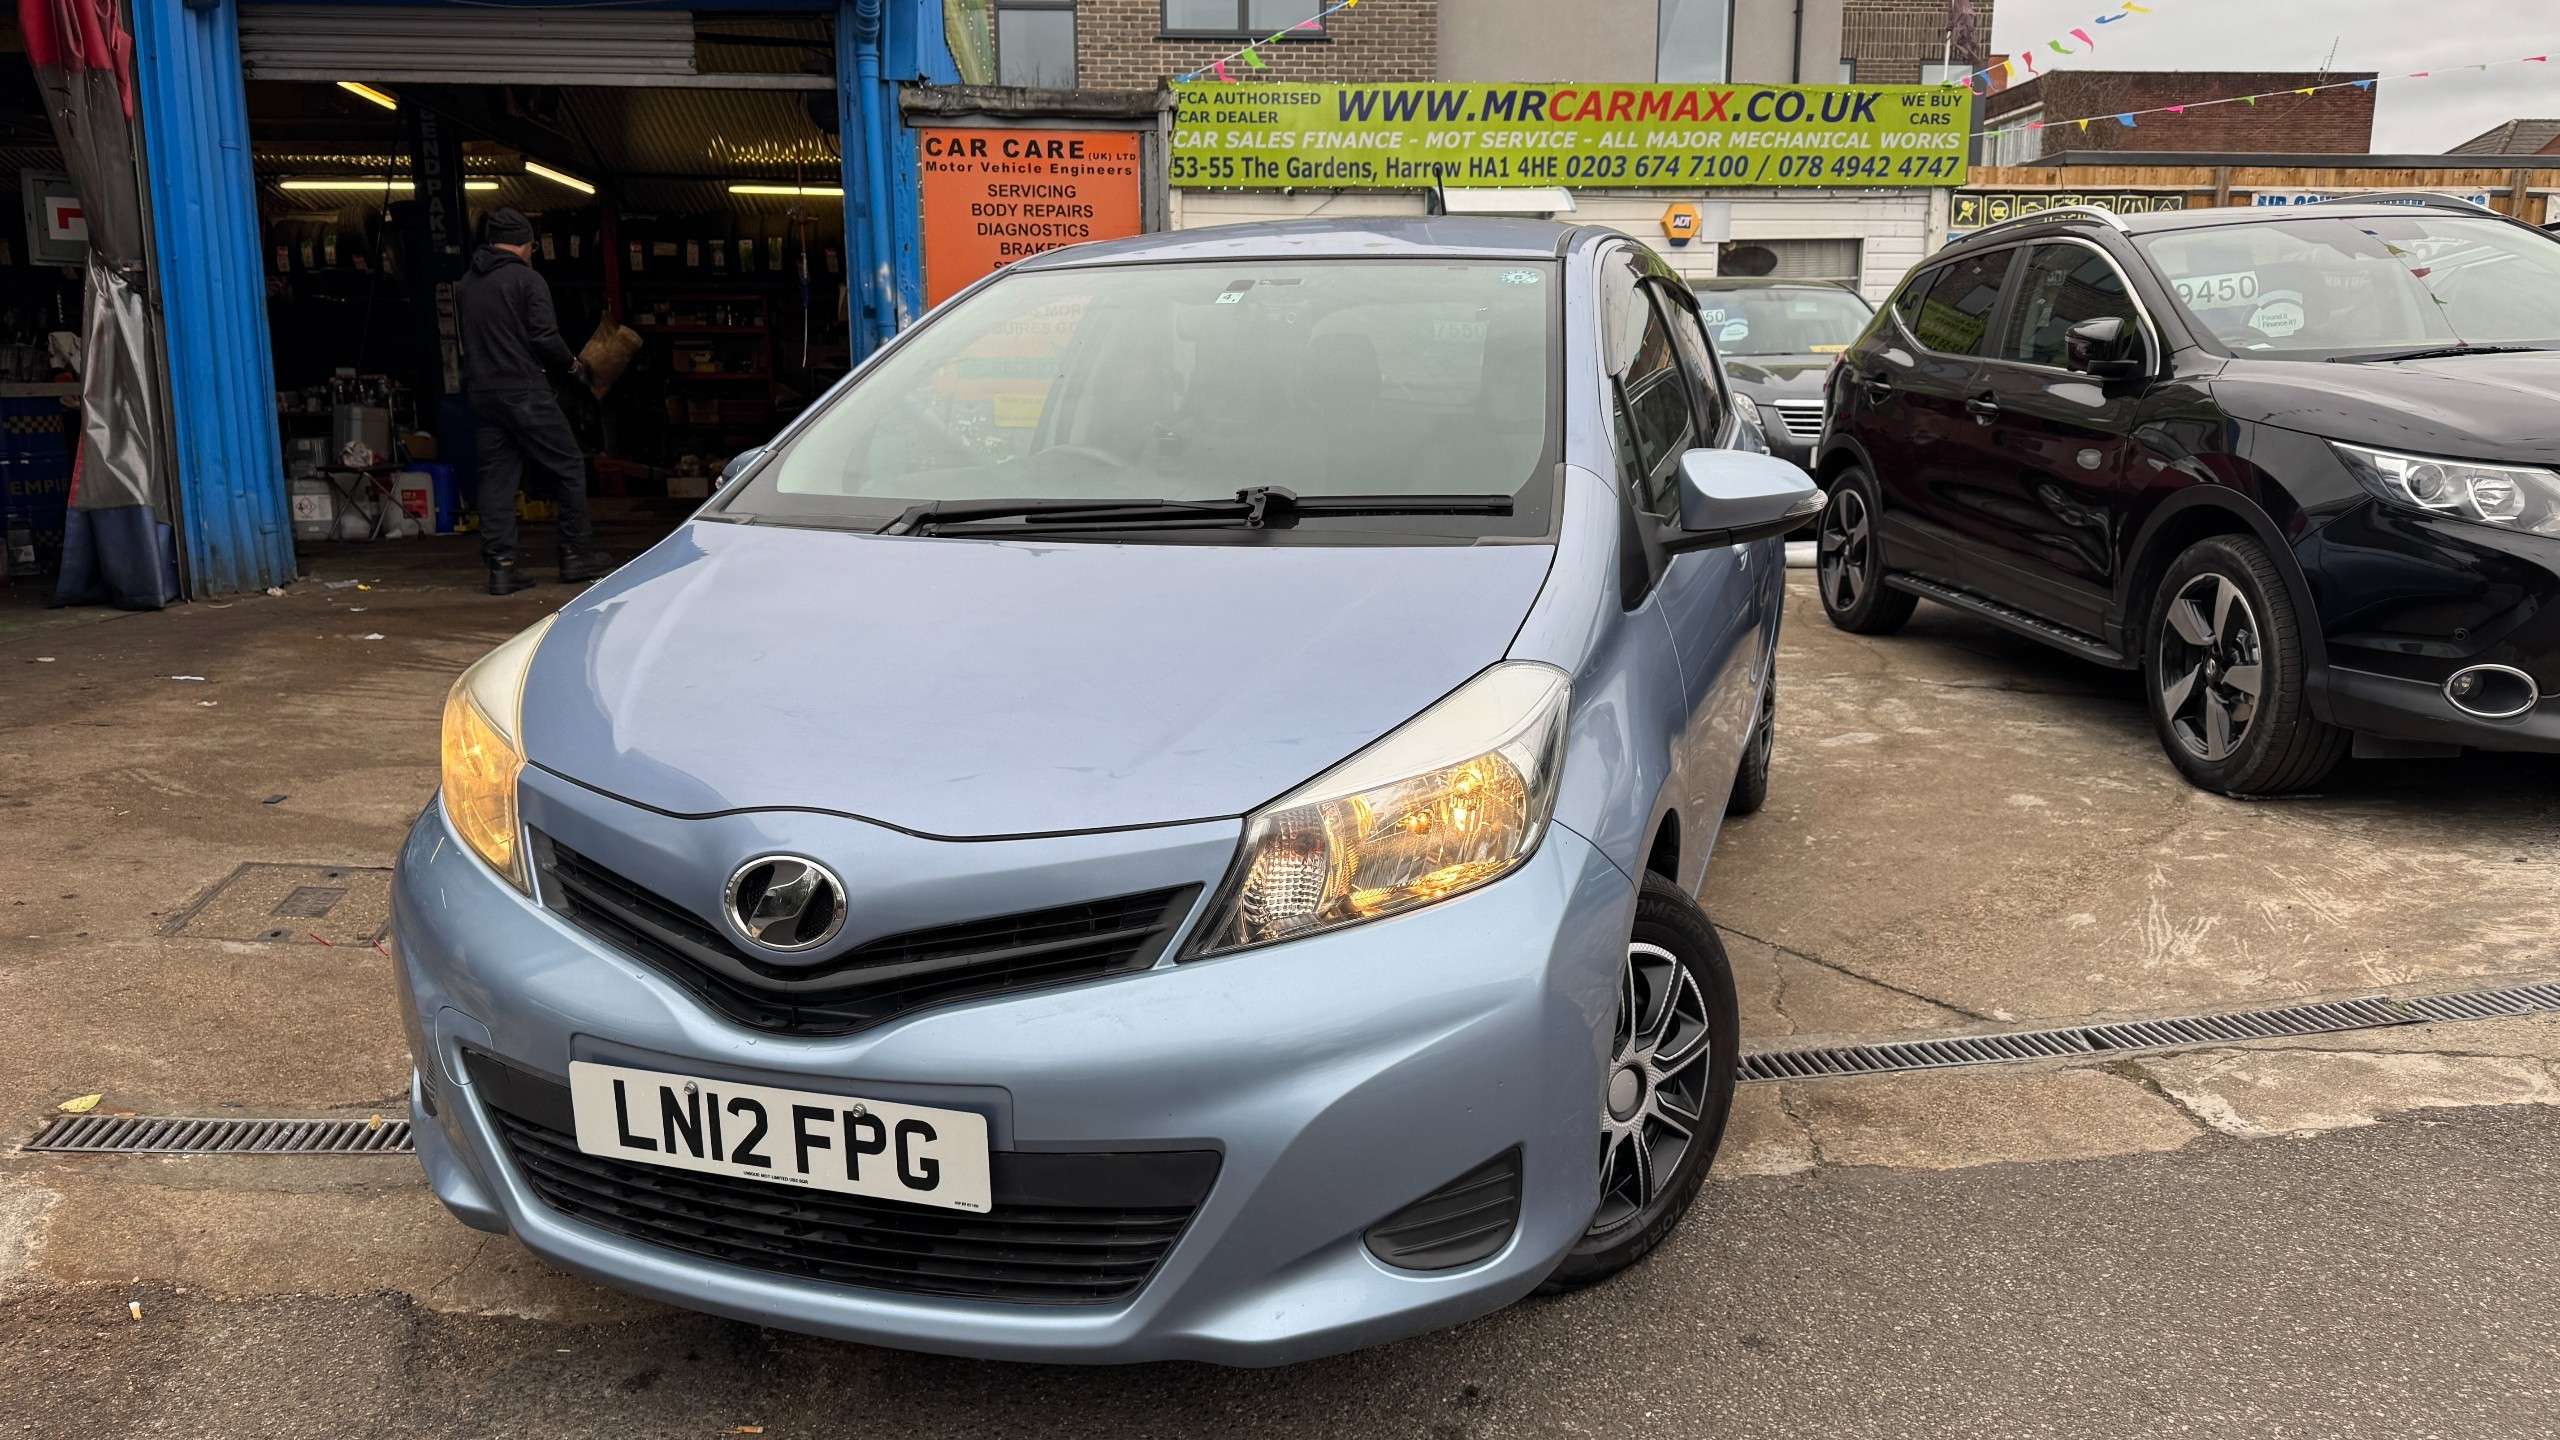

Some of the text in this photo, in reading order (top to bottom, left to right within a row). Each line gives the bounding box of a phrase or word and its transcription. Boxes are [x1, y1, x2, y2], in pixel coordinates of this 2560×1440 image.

[1178, 91, 1321, 105] FCA AUTHORISED
[1902, 95, 1962, 107] WE BUY
[1338, 90, 1882, 123] WWW.MRCARMAX.CO.UK
[1178, 110, 1279, 124] CAR DEALER
[1910, 113, 1951, 125] CARS
[1174, 131, 1223, 149] CAR
[1226, 131, 1296, 149] SALES
[1302, 131, 1403, 149] FINANCE
[1425, 131, 1474, 149] MOT
[1480, 131, 1577, 149] SERVICE
[1598, 131, 1643, 148] ALL
[1646, 131, 1721, 149] MAJOR
[1728, 132, 1870, 149] MECHANICAL
[1879, 132, 1960, 149] WORKS
[925, 137, 1136, 162] CAR CARE (UK) LTD
[925, 161, 1133, 177] Motor Vehicle Engineers
[1173, 157, 1234, 178] 53-55
[1242, 157, 1278, 178] The
[1286, 157, 1378, 182] Gardens,
[1386, 157, 1461, 178] Harrow
[1469, 156, 1510, 178] HA1
[1517, 156, 1558, 178] 4HE
[1566, 155, 1626, 177] 0203
[1635, 155, 1681, 177] 674
[1688, 155, 1749, 177] 7100
[1778, 155, 1823, 177] 078
[1830, 156, 1890, 178] 4942
[1897, 156, 1961, 178] 4747
[987, 184, 1077, 198] SERVICING
[971, 203, 1094, 218] BODY REPAIRS
[977, 223, 1090, 237] DIAGNOSTICS
[2176, 276, 2258, 306] 9450
[612, 1078, 940, 1192] LN12 FPG
